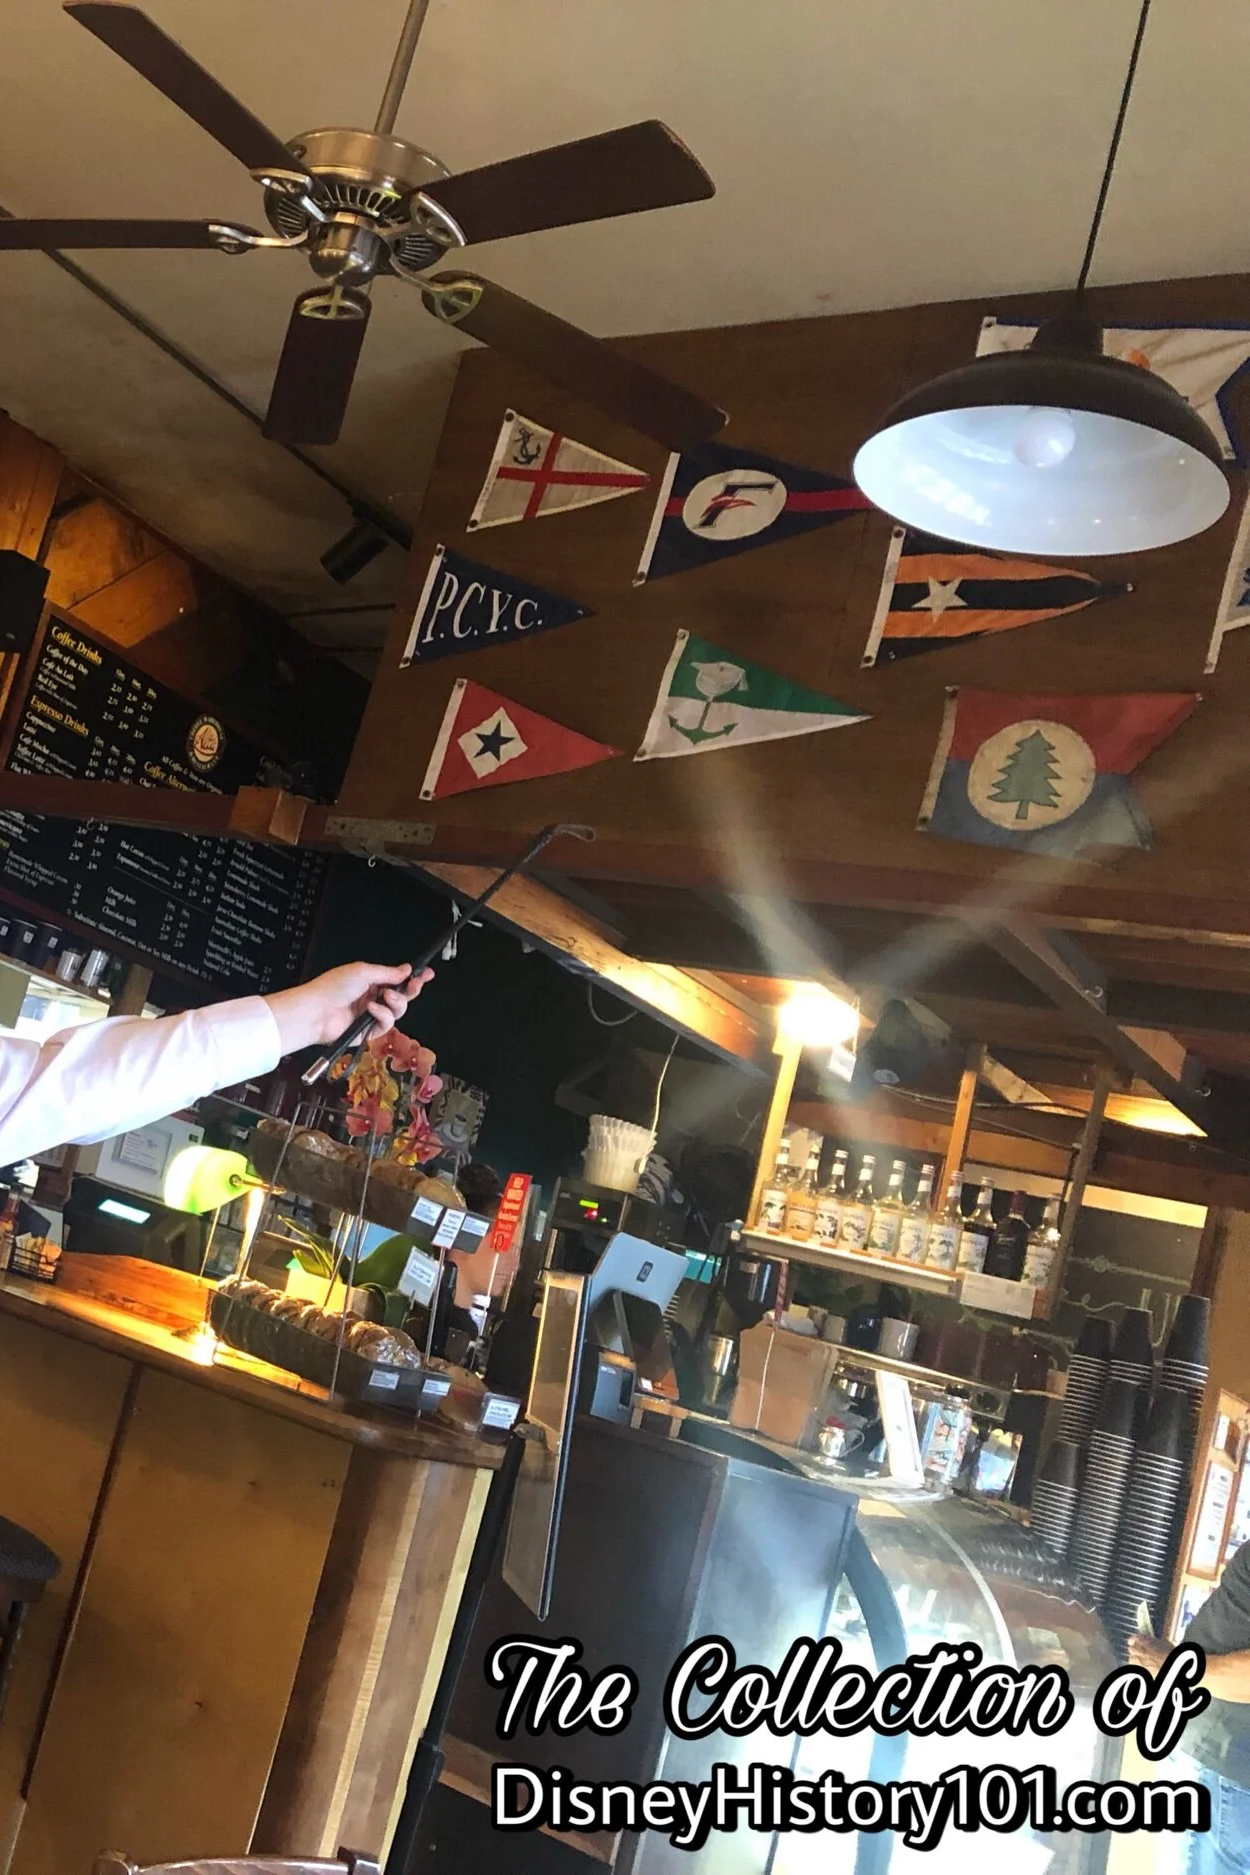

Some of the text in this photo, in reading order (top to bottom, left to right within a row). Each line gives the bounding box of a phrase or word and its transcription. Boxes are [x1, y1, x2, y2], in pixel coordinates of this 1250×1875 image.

[45, 643, 63, 661] Coffee
[77, 662, 89, 676] Day
[50, 625, 103, 664] Coffee Drinks
[29, 695, 90, 736] Espresso Drinks
[143, 760, 166, 782] Coffee
